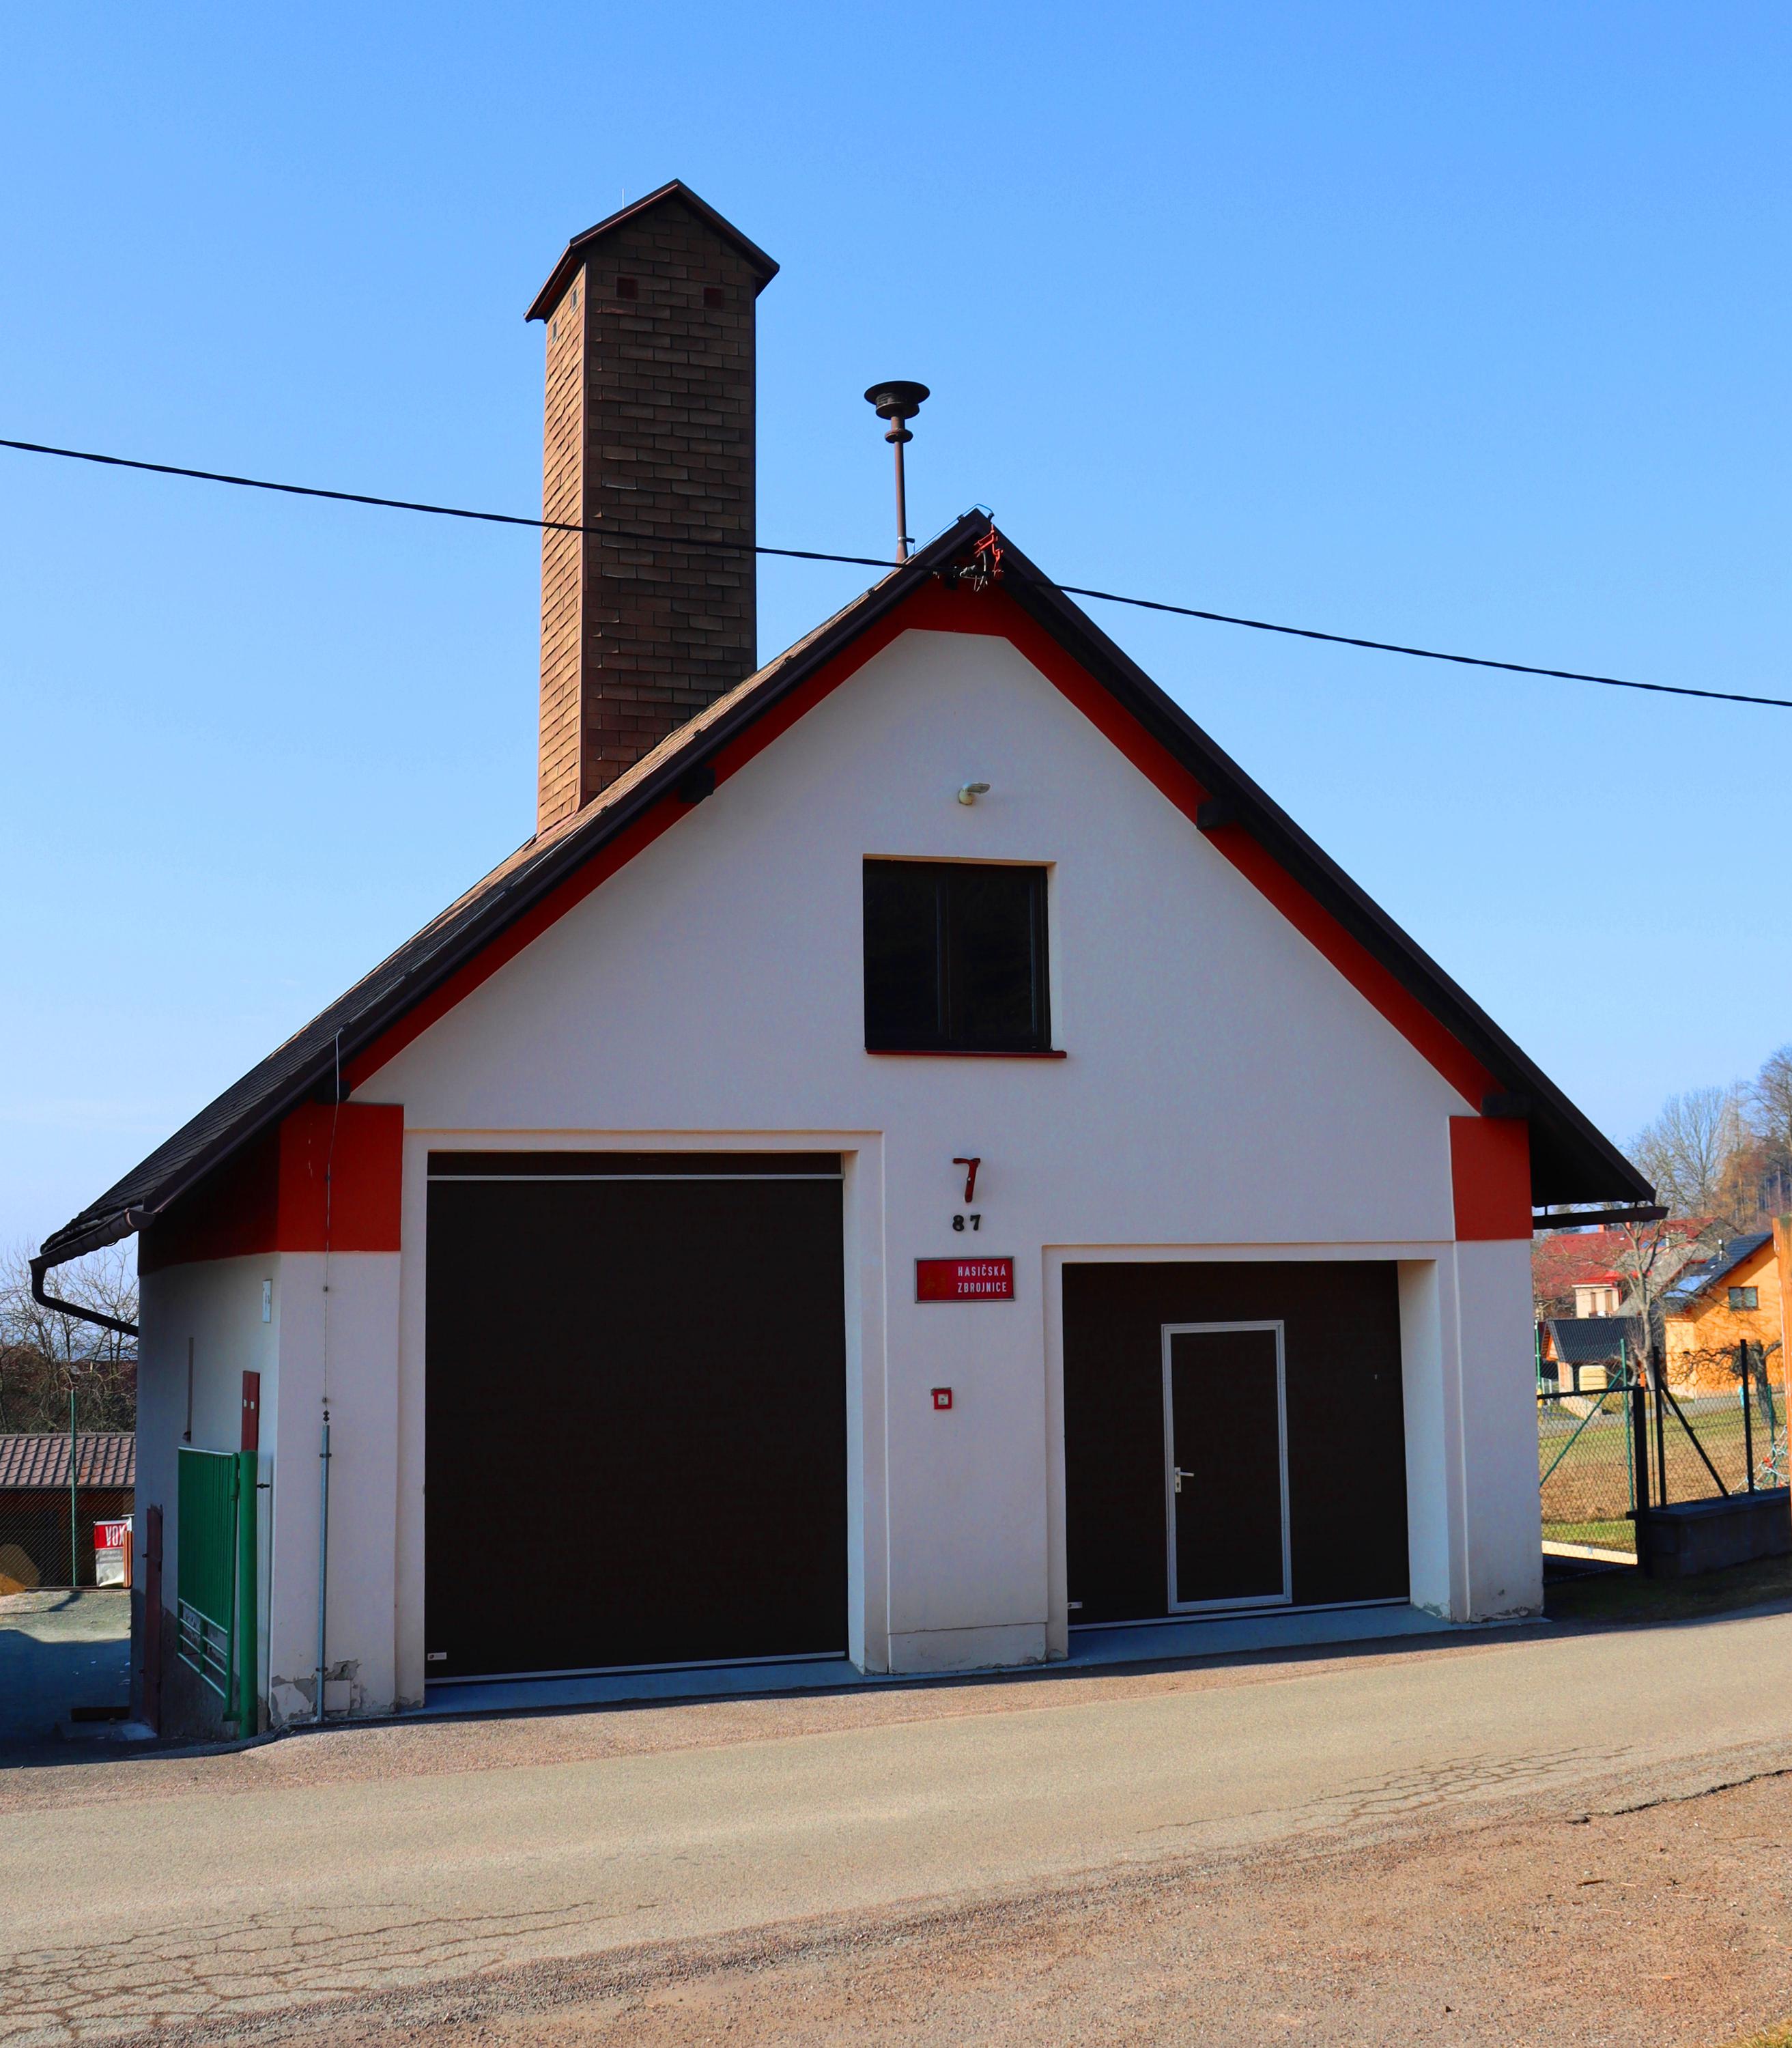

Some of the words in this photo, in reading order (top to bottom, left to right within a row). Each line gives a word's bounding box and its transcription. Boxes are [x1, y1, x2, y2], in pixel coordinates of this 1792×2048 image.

[953, 1158, 980, 1202] 7
[958, 1264, 1006, 1277] HASIČSKÁ
[958, 1282, 1007, 1293] ZBROJNICE
